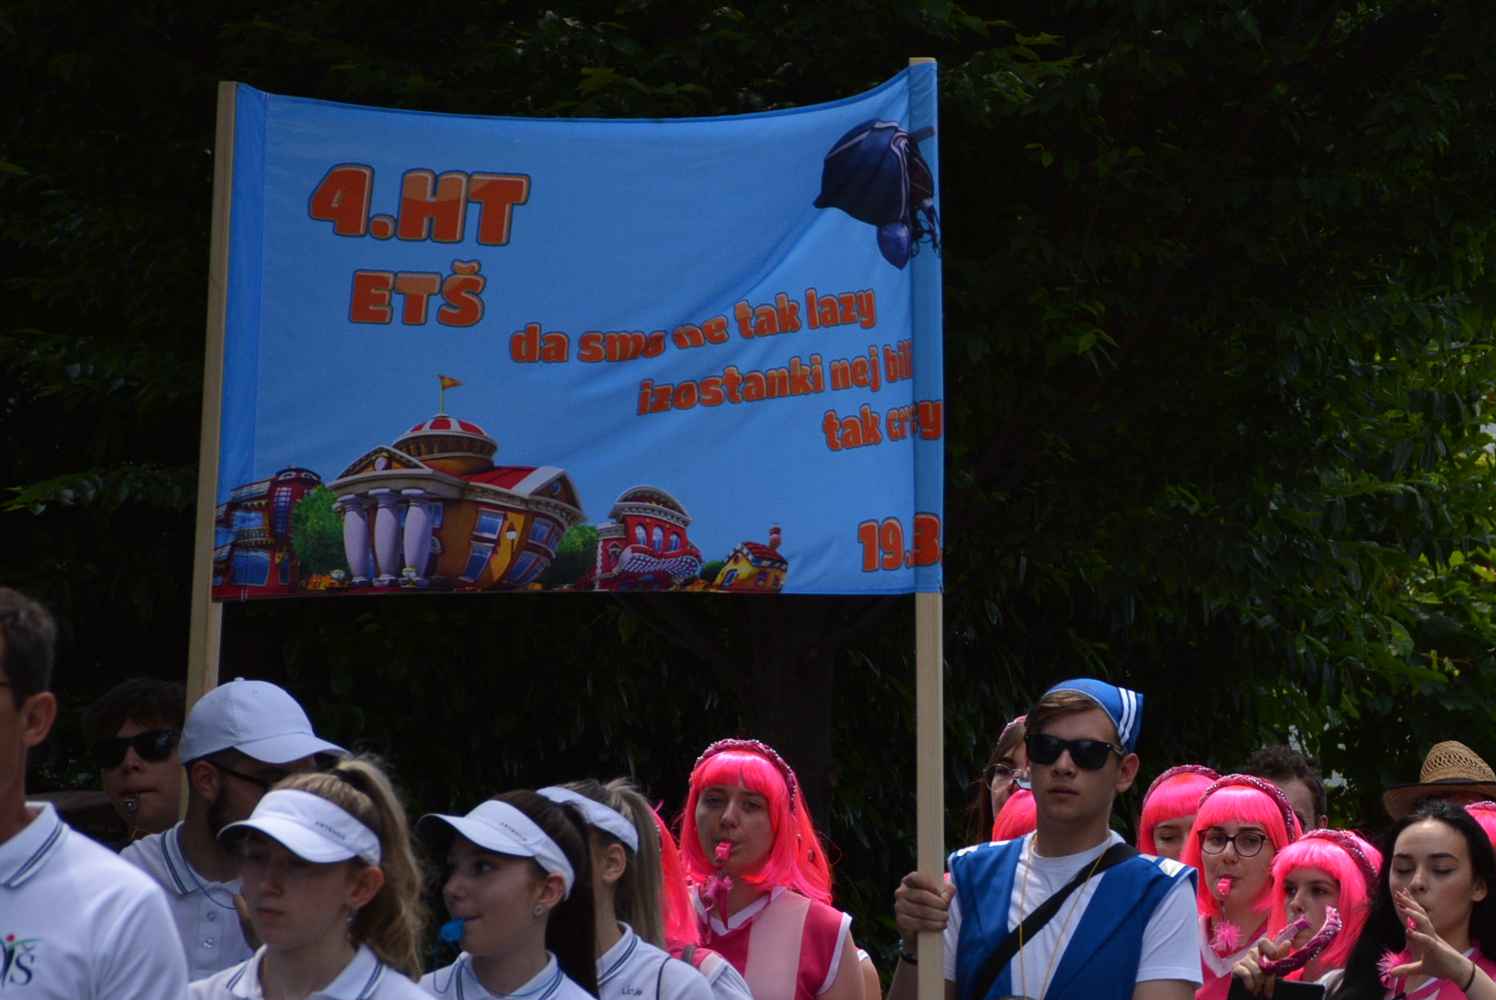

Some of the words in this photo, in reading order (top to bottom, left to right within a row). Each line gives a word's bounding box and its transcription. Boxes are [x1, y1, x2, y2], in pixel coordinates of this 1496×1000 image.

[308, 162, 532, 247] 4.HT
[349, 259, 487, 328] ETŠ
[510, 322, 569, 363] da
[577, 329, 667, 363] smo
[672, 313, 730, 349] ne
[734, 291, 801, 340] tak
[805, 287, 878, 330] lazy
[637, 353, 826, 417] izostanki
[830, 344, 881, 393] nej
[823, 402, 883, 452] tak
